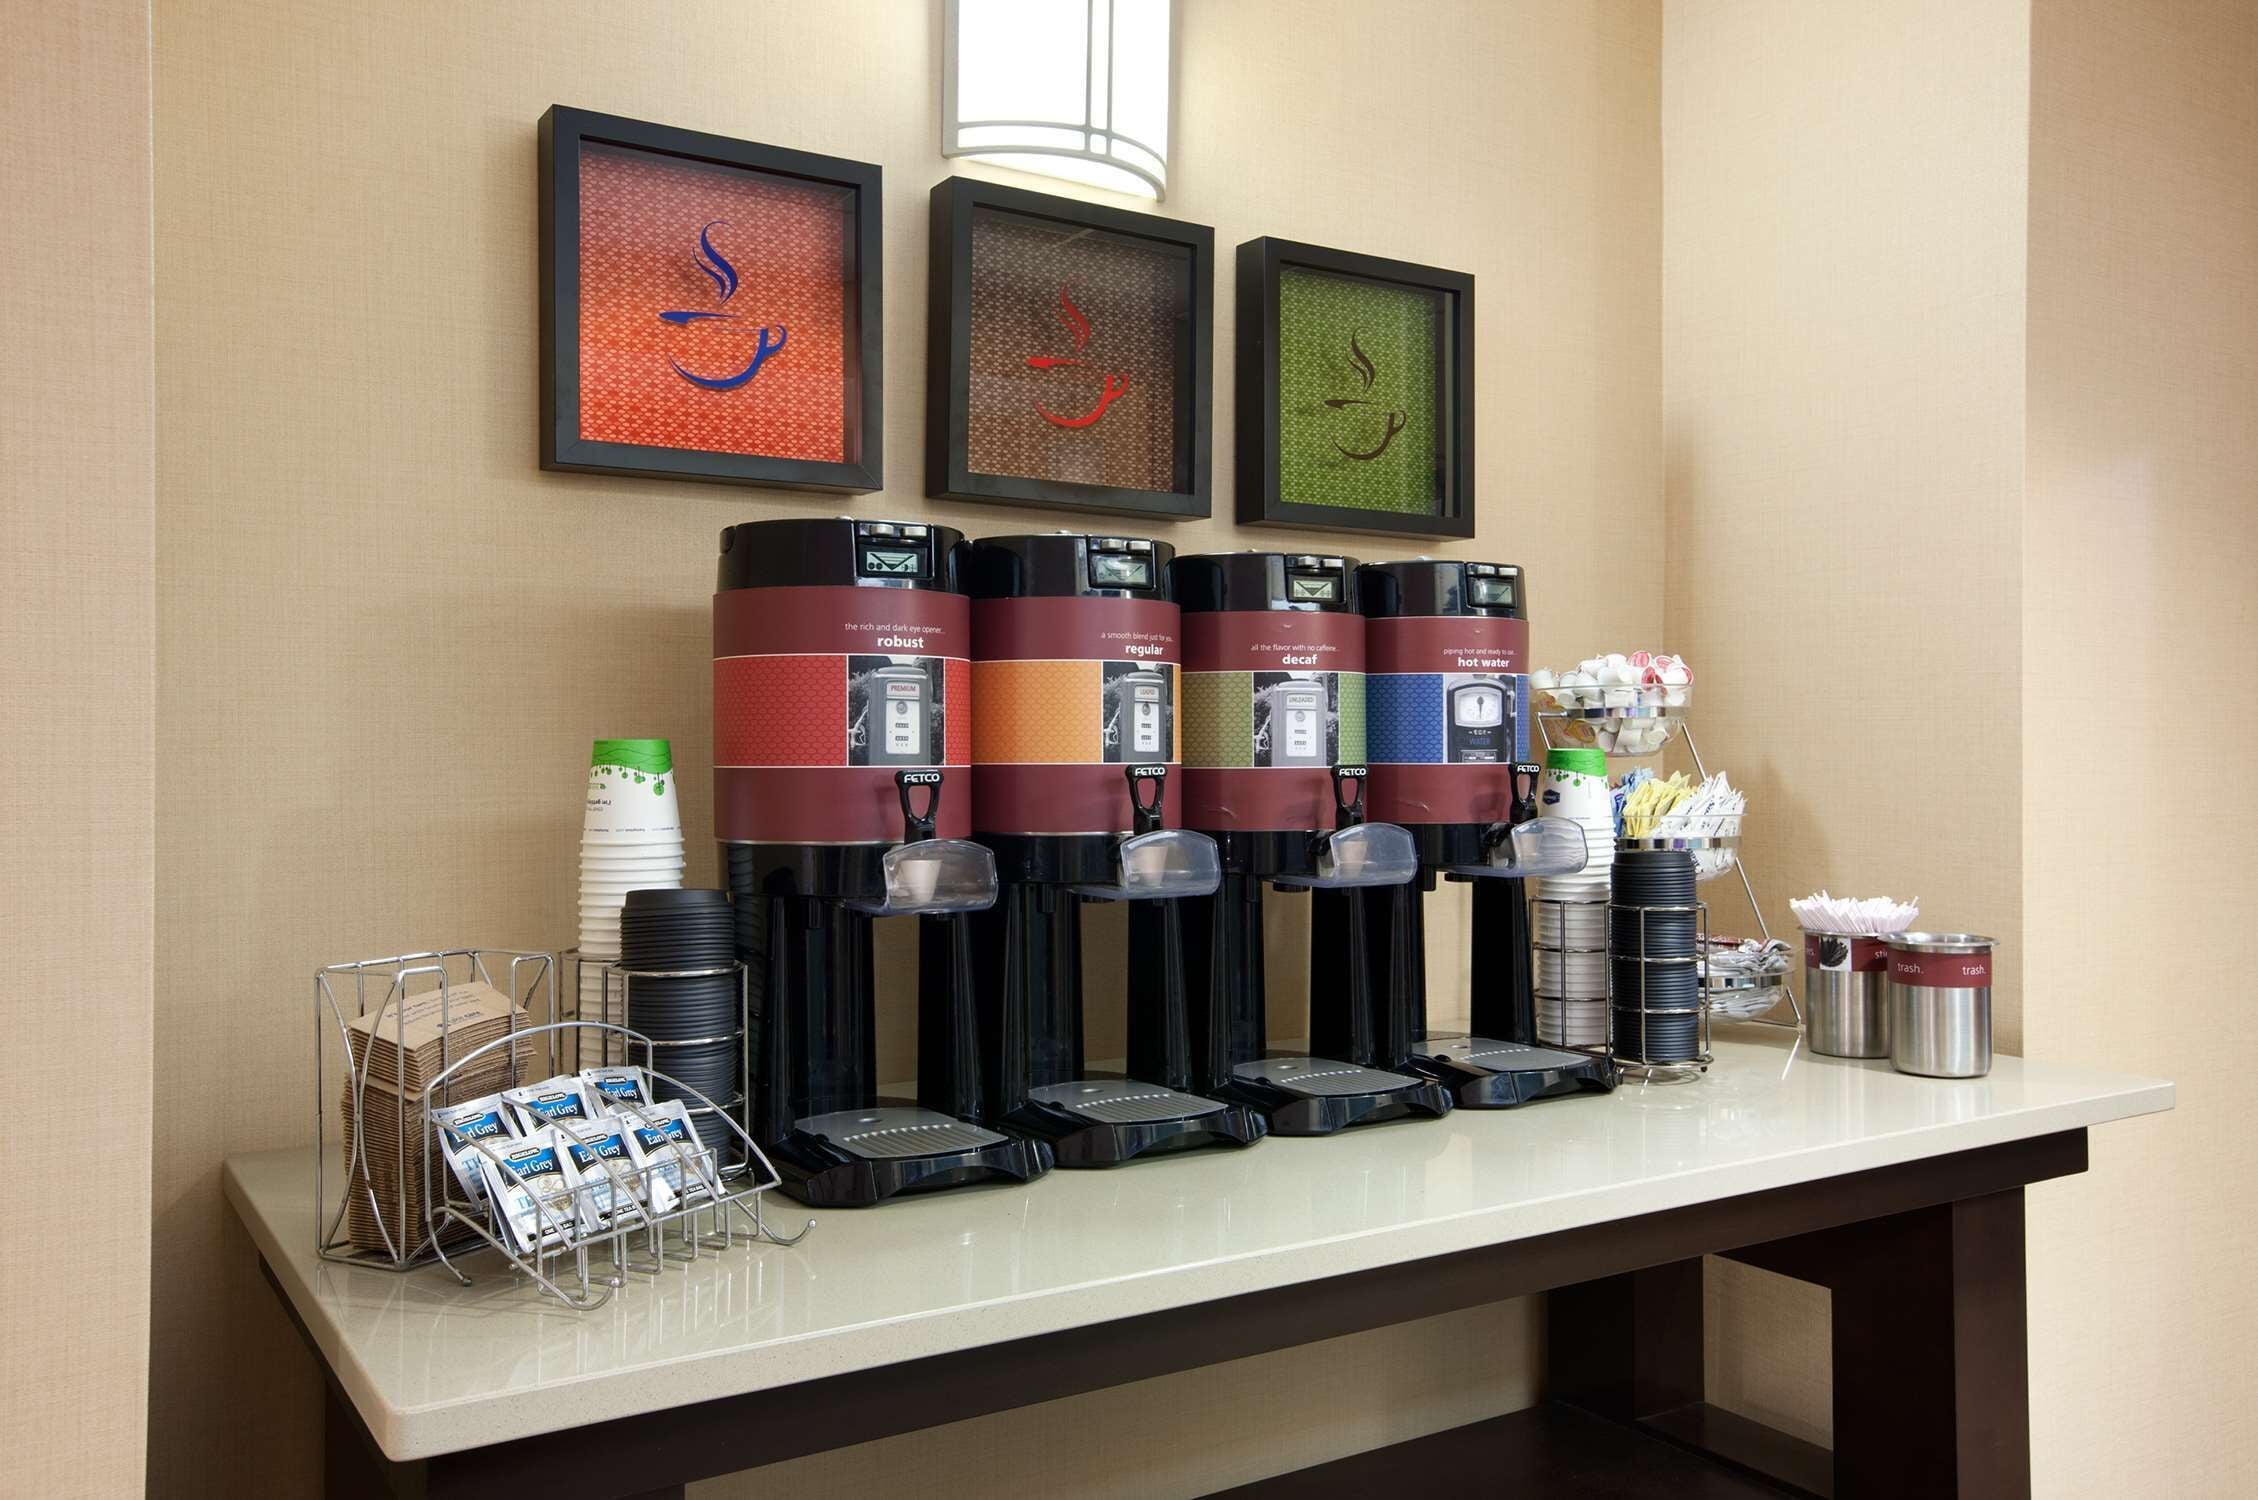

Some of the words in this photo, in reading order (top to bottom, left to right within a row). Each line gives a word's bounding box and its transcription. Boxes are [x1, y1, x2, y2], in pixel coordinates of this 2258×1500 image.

[845, 622, 858, 631] the
[860, 622, 874, 631] rich
[875, 623, 891, 632] and
[892, 623, 908, 632] dark
[909, 626, 921, 634] eye
[877, 634, 924, 648] robust
[1107, 631, 1132, 640] smooth
[1133, 631, 1149, 641] blend
[1125, 643, 1164, 657] regular
[1251, 643, 1259, 651] all
[1260, 643, 1271, 651] the
[1272, 643, 1290, 652] flavor
[1291, 643, 1306, 651] with
[1464, 647, 1474, 655] hot
[1475, 647, 1487, 655] and
[1488, 648, 1501, 656] ready
[1282, 653, 1318, 665] decaf
[1458, 656, 1478, 667] hot
[1481, 657, 1510, 668] water
[1134, 766, 1166, 777] FETCO
[1339, 768, 1367, 777] FETCO
[1517, 764, 1540, 773] FETCO
[904, 773, 941, 784] FETCO
[1897, 962, 1924, 975] trash.
[1961, 966, 1986, 976] trash.
[620, 1086, 638, 1099] Grey
[557, 1103, 578, 1115] Grey
[475, 1120, 499, 1134] Grey
[599, 1144, 621, 1157] Grey
[531, 1158, 553, 1172] Grey
